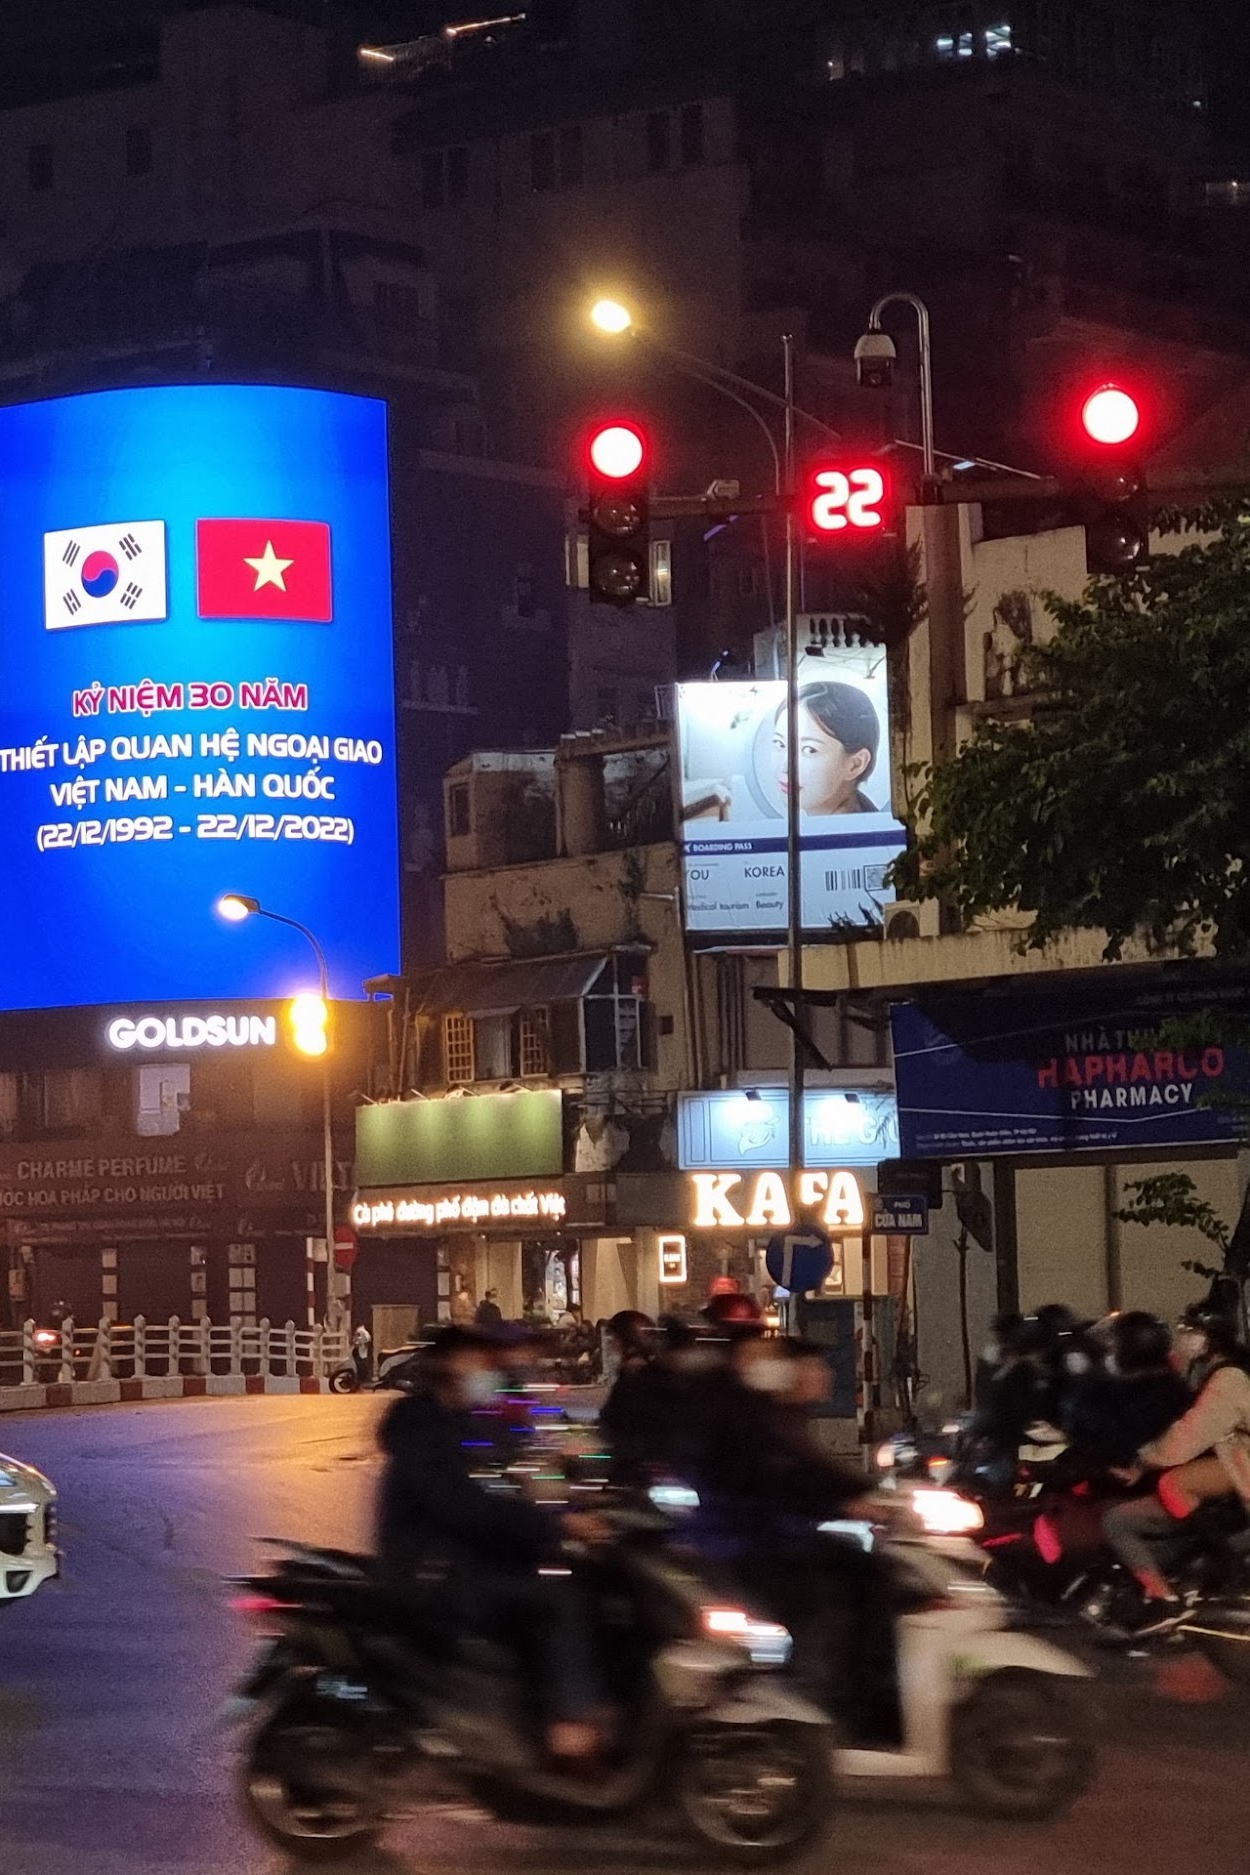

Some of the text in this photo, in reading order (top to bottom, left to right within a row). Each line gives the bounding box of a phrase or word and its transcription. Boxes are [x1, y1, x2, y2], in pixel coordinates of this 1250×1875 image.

[812, 468, 884, 529] 22
[72, 676, 309, 718] KỶ NIỆM 30 NĂM
[62, 734, 106, 769] LẬP
[111, 734, 192, 760] QUAN
[200, 727, 240, 764] HỆ
[248, 732, 330, 764] NGOẠI
[333, 739, 383, 765] GIAO
[50, 774, 100, 810] VIỆT
[105, 774, 167, 801] NAM
[193, 768, 256, 798] HÀN
[262, 766, 336, 800] QUỐC
[36, 815, 174, 851] (22/12/1992
[197, 813, 355, 845] 22/12/2022)
[693, 842, 752, 852] BOARDING PASS
[744, 866, 785, 879] KOREA
[719, 902, 750, 911] tourism
[755, 901, 784, 911] Beauty
[108, 1016, 276, 1049] GOLDSUN
[1064, 1026, 1111, 1053] NHÀ
[1037, 1045, 1226, 1089] HAPHARCO
[1070, 1083, 1194, 1111] PHARMACY
[17, 1159, 95, 1181] CHARME
[98, 1155, 187, 1178] PERFUME
[28, 1190, 57, 1206] HOA
[104, 1186, 137, 1203] CHO
[353, 1202, 371, 1225] Cà
[371, 1201, 394, 1226] phê
[436, 1195, 461, 1223] phố
[539, 1193, 566, 1221] Việt
[897, 1214, 923, 1228] NAM
